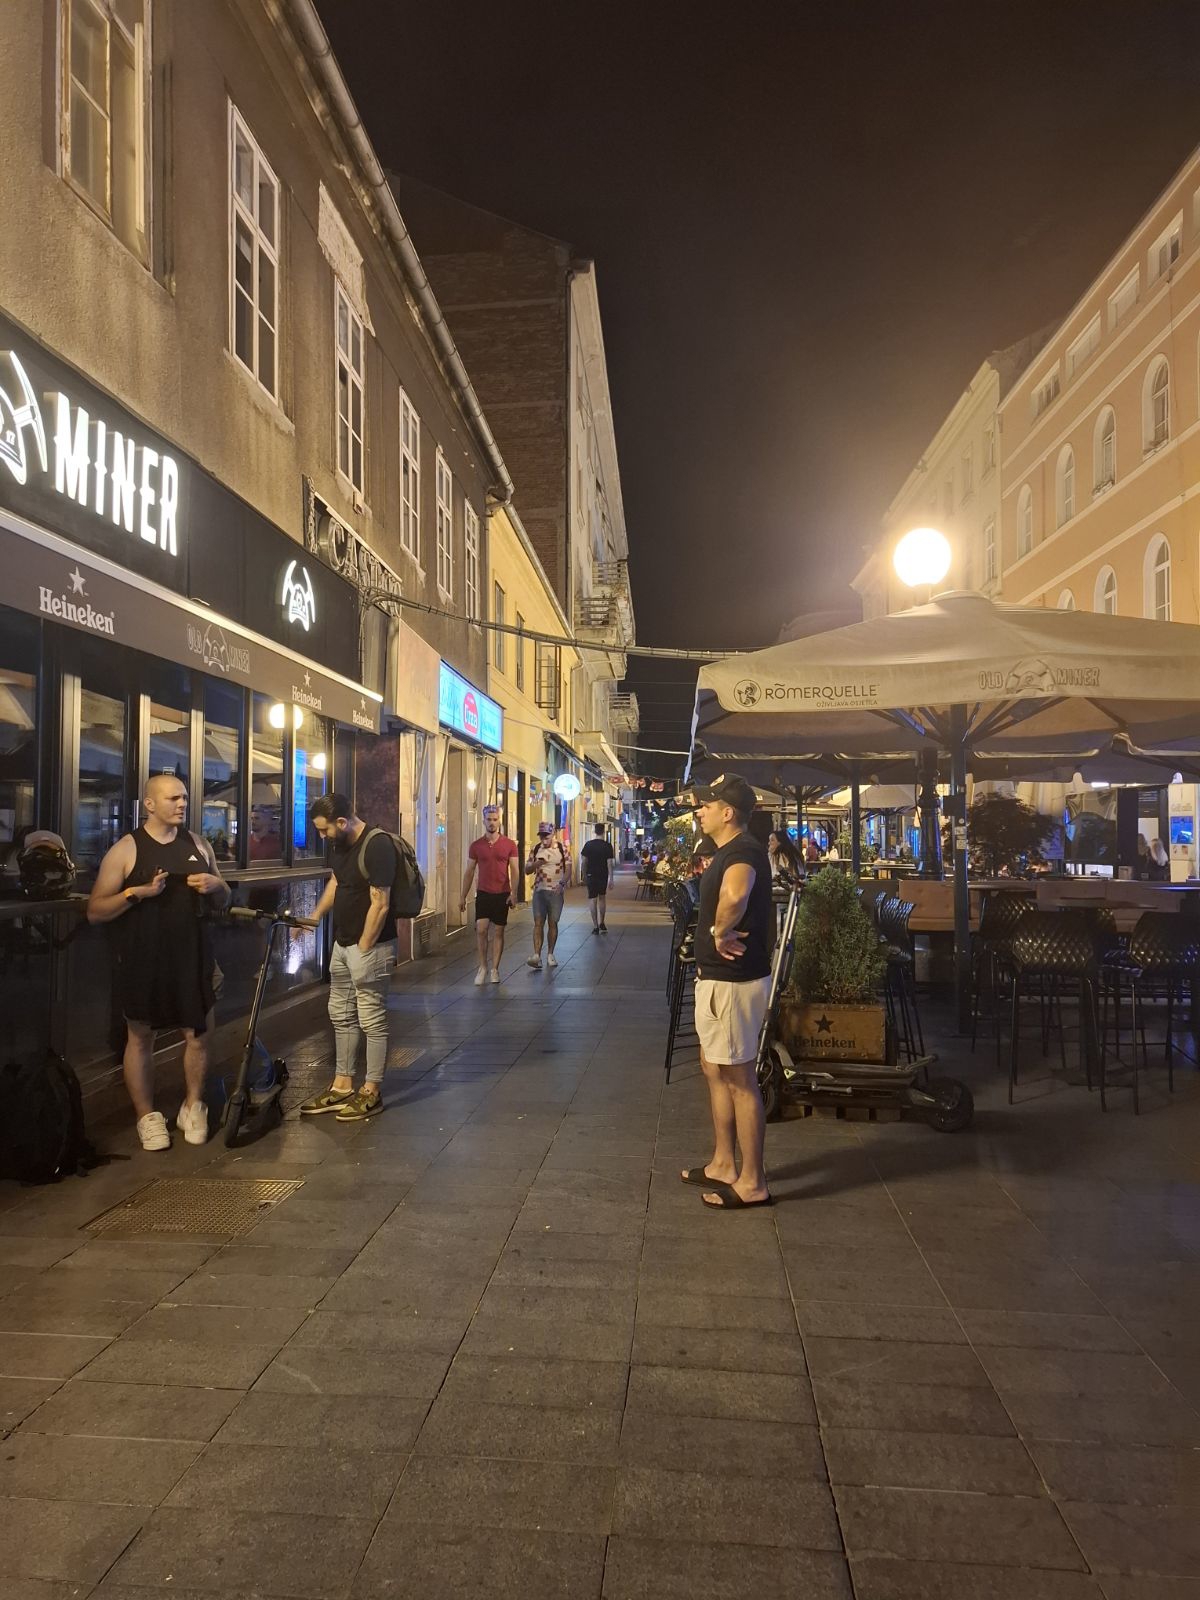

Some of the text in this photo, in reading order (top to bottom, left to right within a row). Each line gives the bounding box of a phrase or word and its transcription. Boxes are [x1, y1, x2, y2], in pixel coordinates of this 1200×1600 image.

[54, 391, 178, 557] MINER
[39, 586, 115, 635] Heineken
[978, 666, 1100, 690] OLD MINER
[292, 685, 322, 711] Heineken
[352, 709, 375, 730] Heineken
